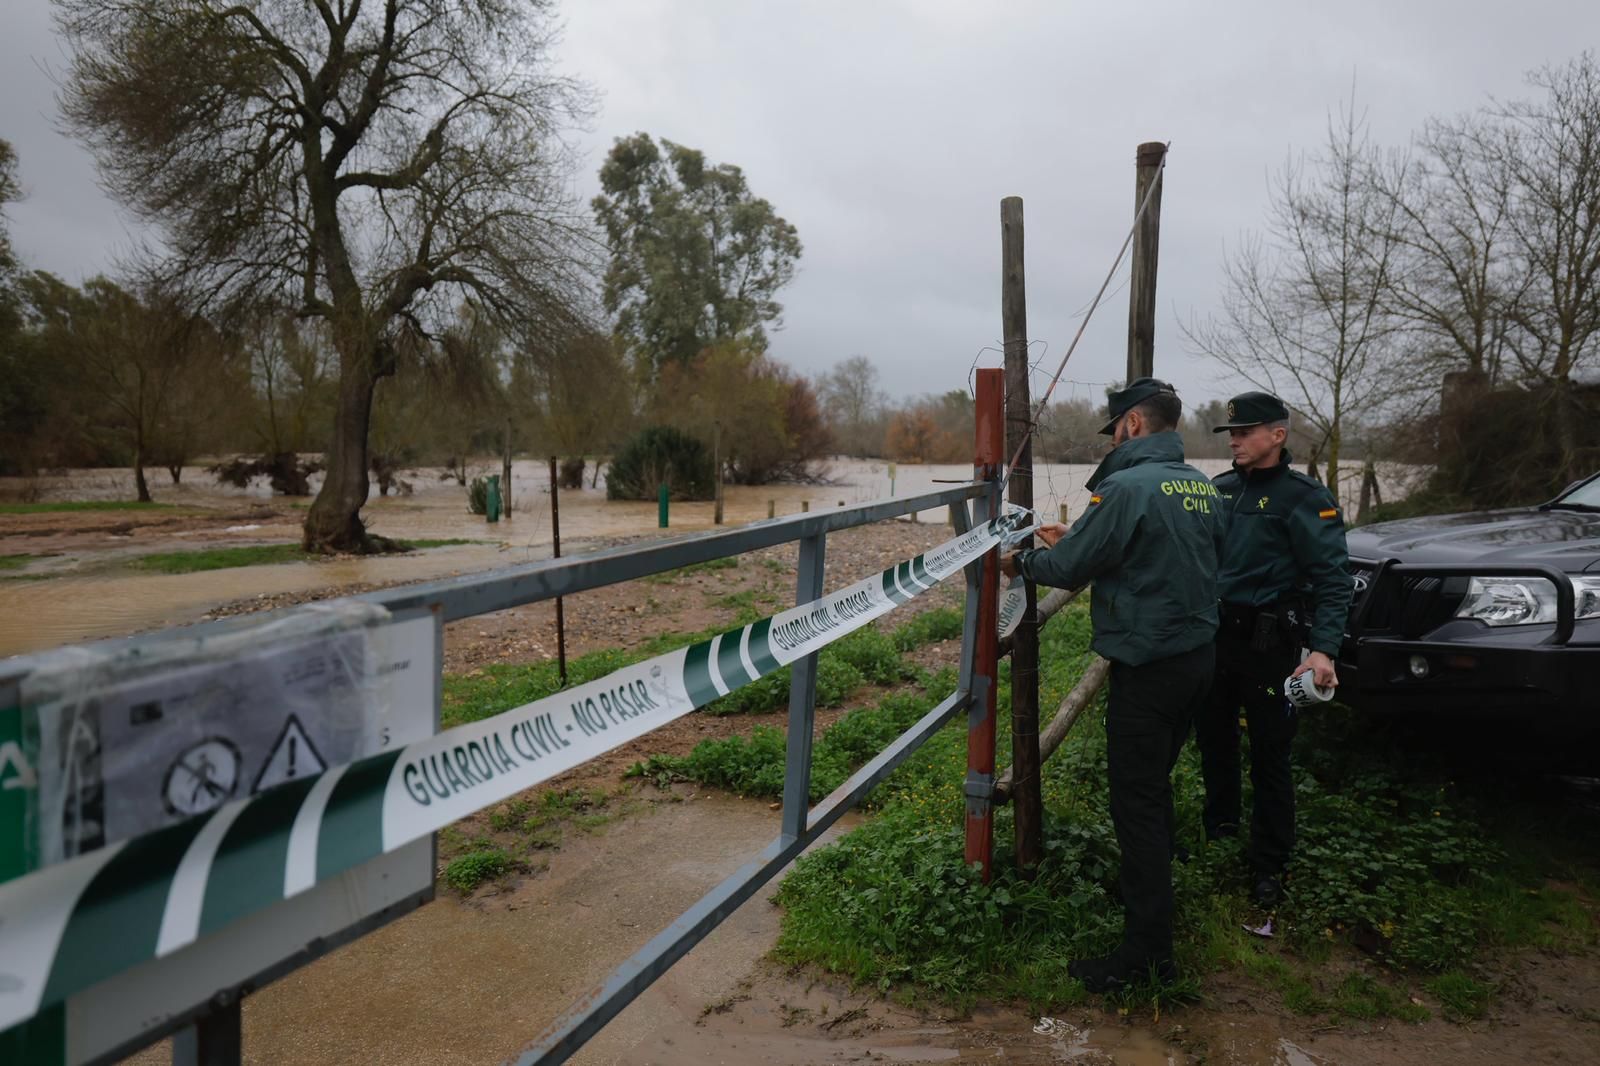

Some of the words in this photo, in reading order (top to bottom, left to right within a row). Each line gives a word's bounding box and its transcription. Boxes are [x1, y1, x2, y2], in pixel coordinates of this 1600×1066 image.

[1161, 480, 1217, 498] GUARDIA
[1183, 496, 1210, 513] CVIL
[772, 616, 821, 651] GUARDIA
[810, 607, 841, 632] CIVIL
[403, 732, 518, 806] GUARDIA
[511, 712, 571, 763] CIVIL
[571, 697, 603, 737] NO
[602, 679, 660, 725] PASAR
